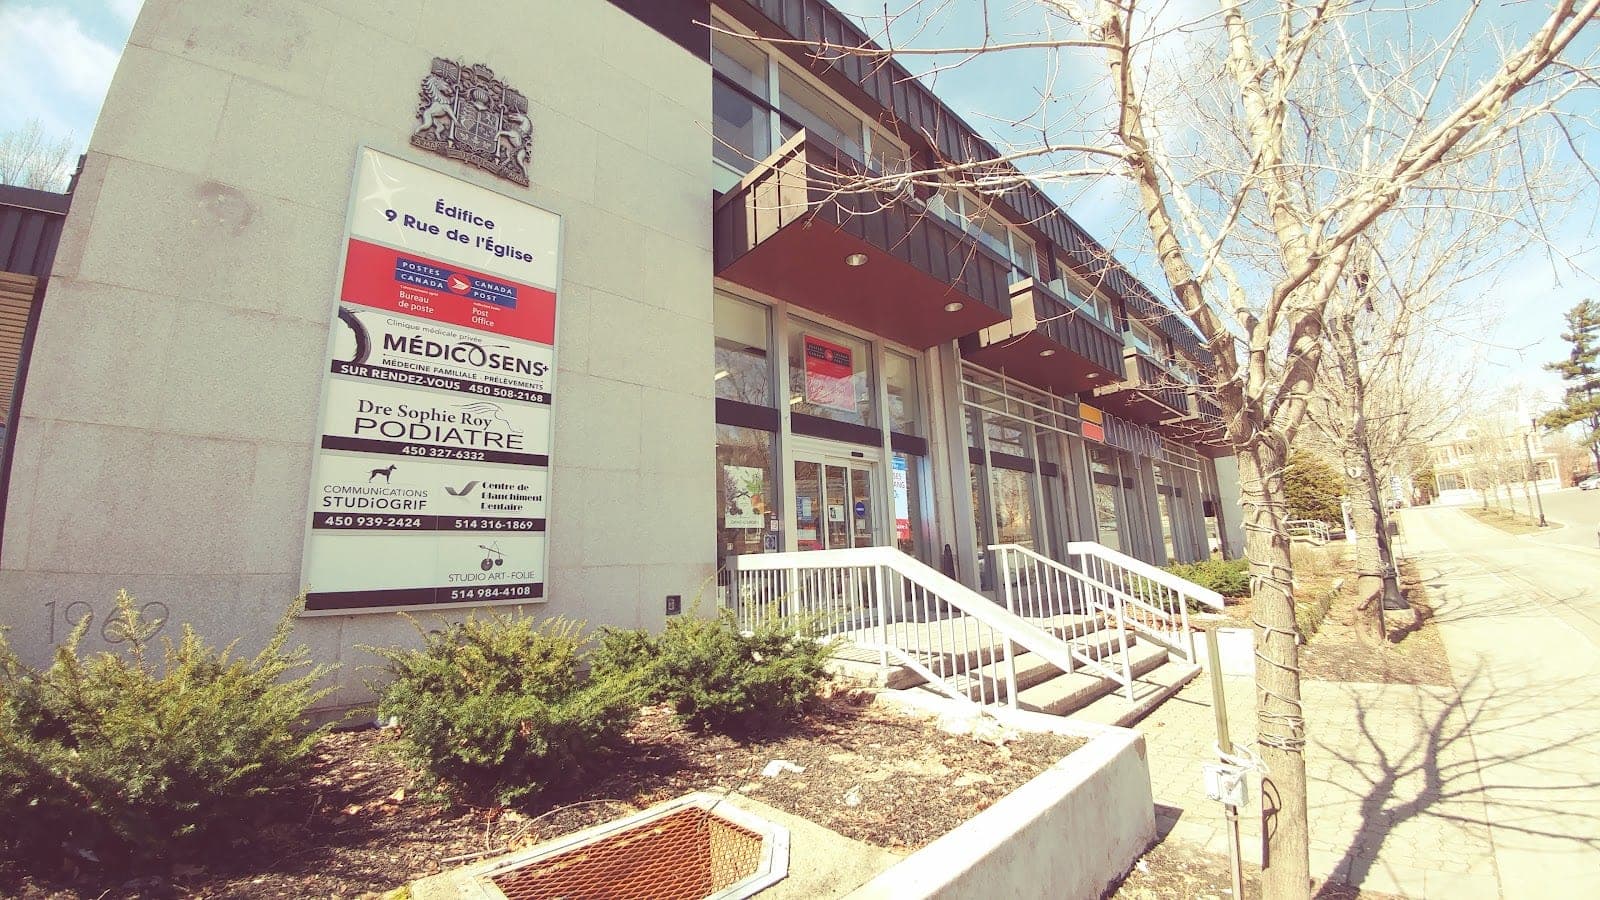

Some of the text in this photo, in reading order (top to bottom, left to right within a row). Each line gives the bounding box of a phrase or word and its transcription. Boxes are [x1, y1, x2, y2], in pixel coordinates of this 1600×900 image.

[435, 199, 495, 229] Édifice
[385, 209, 533, 263] 9 Rue de l'Église
[402, 261, 440, 276] POSTES
[401, 273, 444, 289] CANADA
[474, 280, 513, 295] CANADA
[399, 290, 429, 304] Bureau
[473, 291, 497, 302] POST
[398, 300, 434, 314] de poste
[472, 307, 489, 318] Post
[386, 318, 420, 336] Clinique
[422, 326, 457, 338] médicale
[471, 315, 495, 327] Office
[382, 358, 544, 391] MÉDECINE FAMILIALE PRÉLÈVEMENTS
[340, 364, 543, 403] SUR RENDEZ-VOUS 450 508-2168
[358, 399, 493, 433] Dre Sophie Roy
[354, 417, 524, 450] PODIATRE
[402, 446, 485, 461] 450 327-6332
[482, 482, 515, 490] Centre
[480, 502, 523, 511] Dentaire
[325, 516, 421, 528] 450 939-2424
[455, 519, 533, 529] 514 316-1869
[448, 572, 487, 582] STUDIO
[451, 586, 531, 599] 514 984-4108
